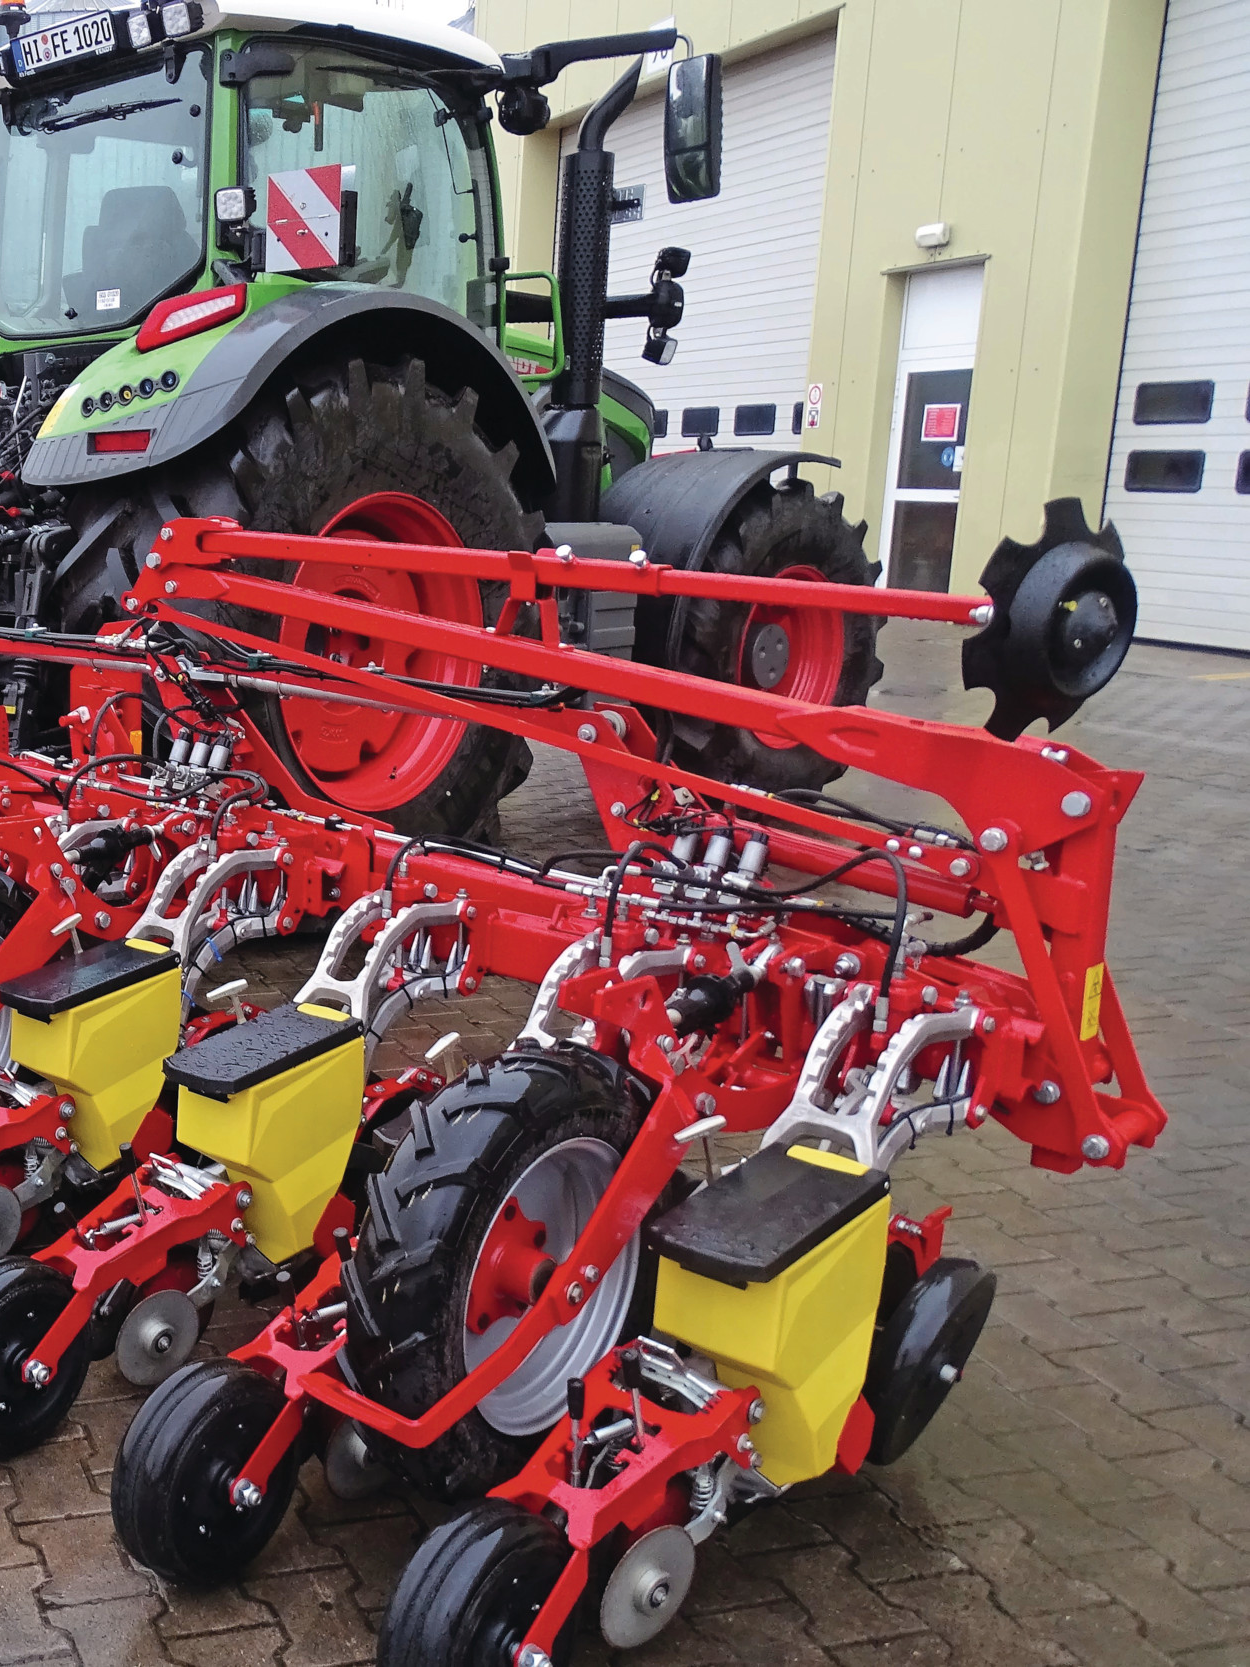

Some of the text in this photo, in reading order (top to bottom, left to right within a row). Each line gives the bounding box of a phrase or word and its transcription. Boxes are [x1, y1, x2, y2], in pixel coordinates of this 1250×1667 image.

[22, 17, 111, 66] HI FE 1020
